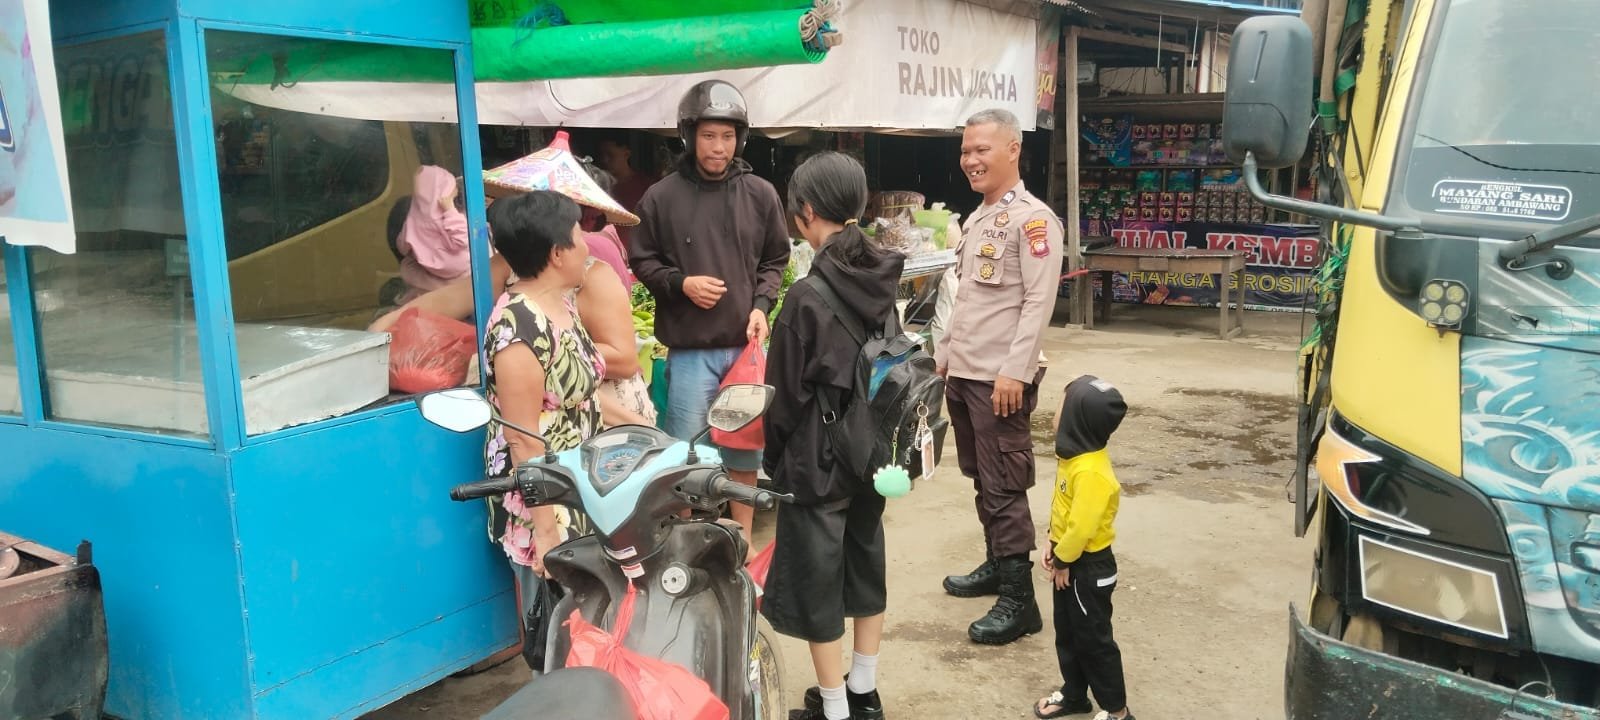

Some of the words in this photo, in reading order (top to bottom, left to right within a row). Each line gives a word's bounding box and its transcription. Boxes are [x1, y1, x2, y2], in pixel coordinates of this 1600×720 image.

[898, 26, 940, 55] TOKO
[898, 62, 965, 97] RAJIN
[1439, 188, 1514, 201] MAYANG
[1519, 192, 1566, 204] SARI
[1481, 184, 1523, 193] BENGKEL
[1498, 199, 1561, 212] AMBAWANG
[982, 229, 1007, 240] POLRI
[1127, 270, 1215, 289] HARGA
